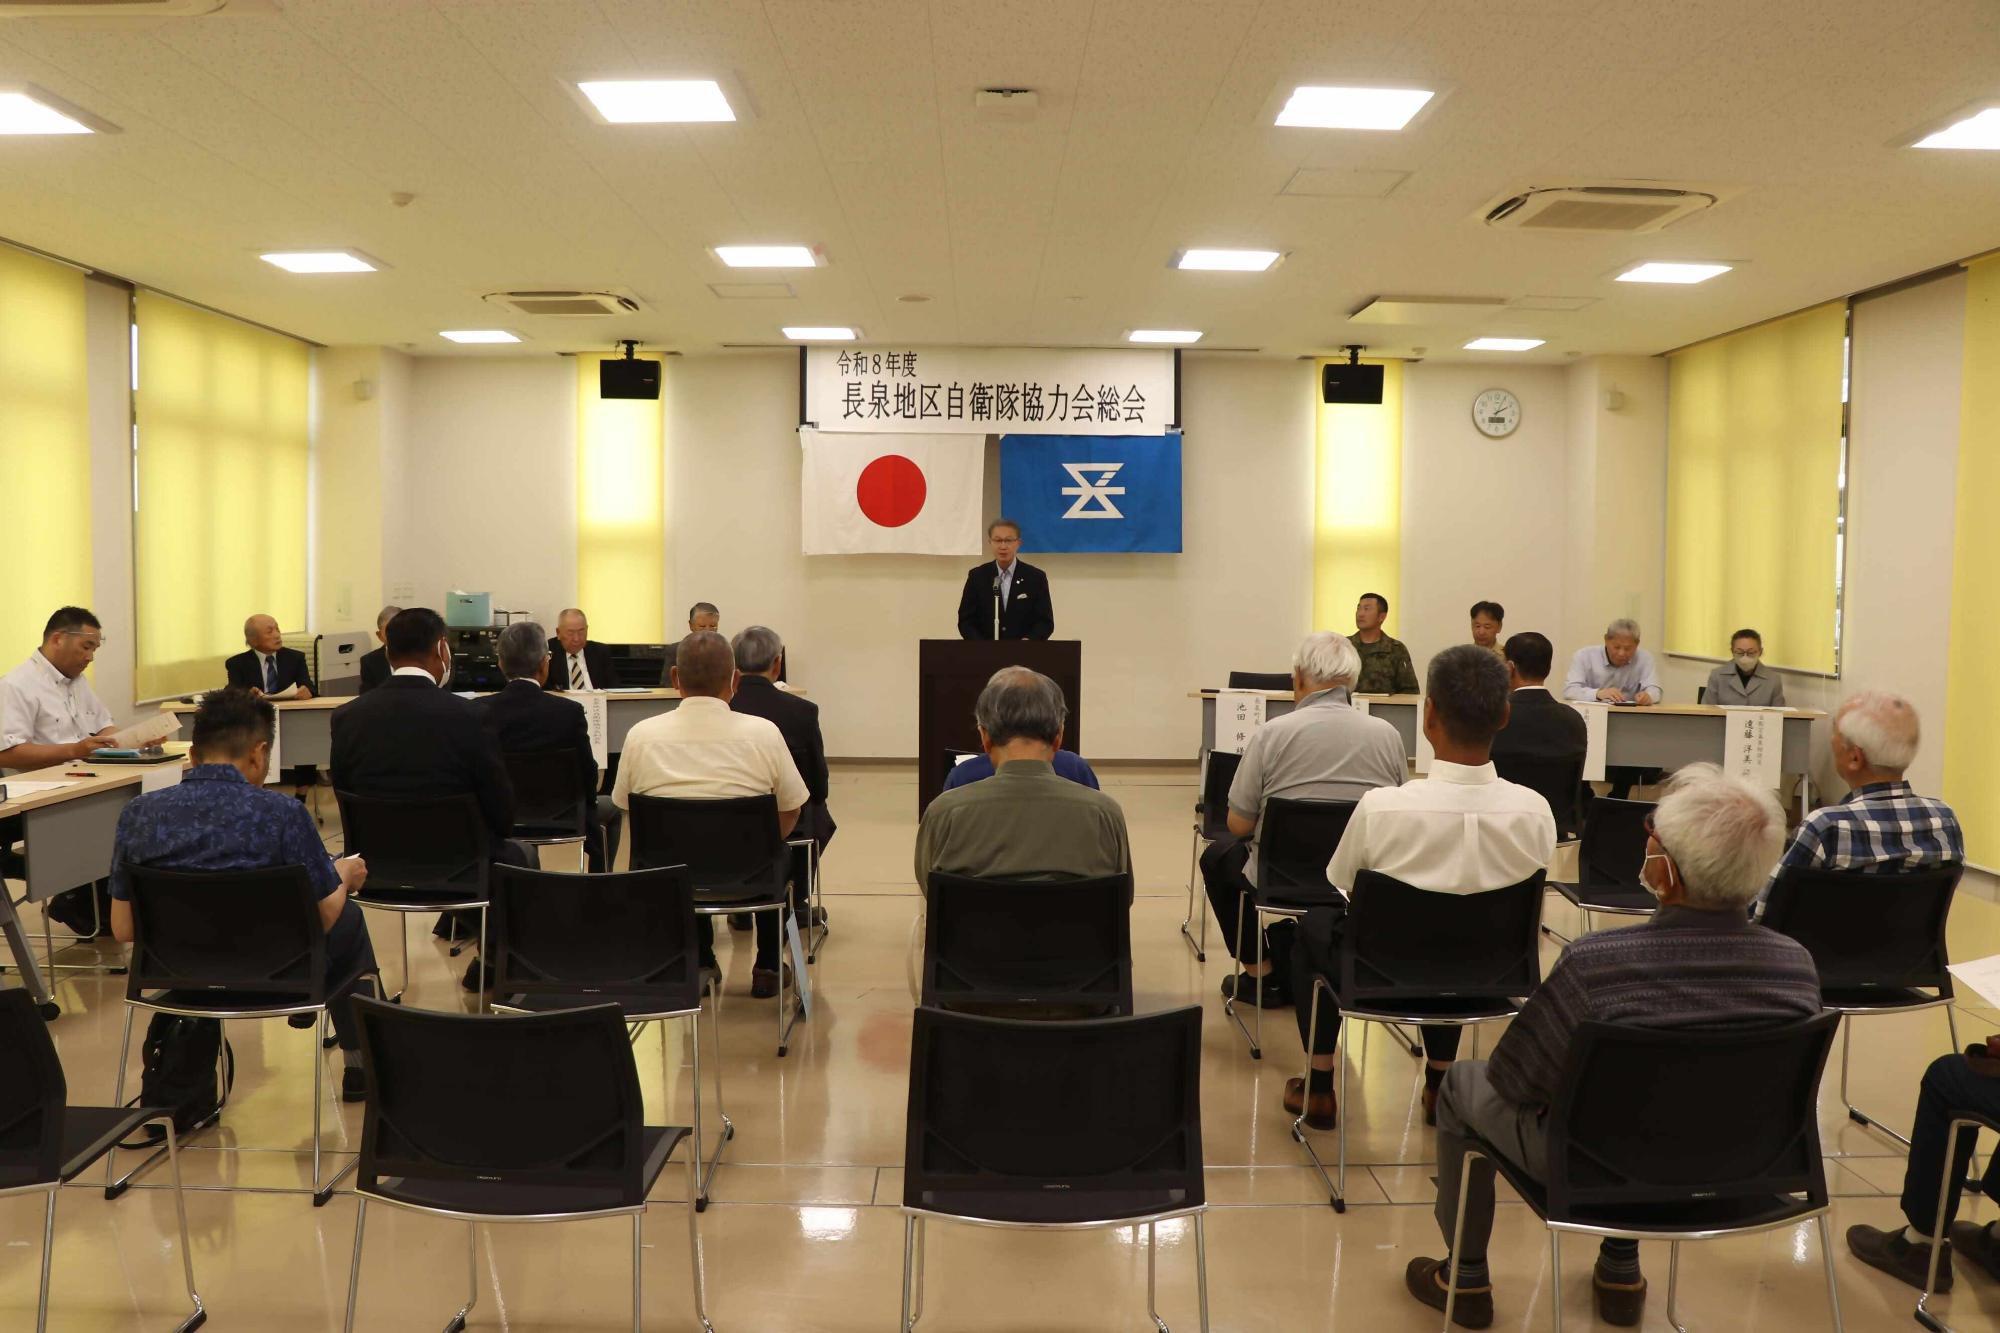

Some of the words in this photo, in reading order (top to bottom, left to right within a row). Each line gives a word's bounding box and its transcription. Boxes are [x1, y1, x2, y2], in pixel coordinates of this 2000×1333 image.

[836, 350, 917, 378] 令和8年度
[842, 380, 1146, 423] 長泉地区自衛隊協力会総会
[1236, 703, 1247, 721] 池田
